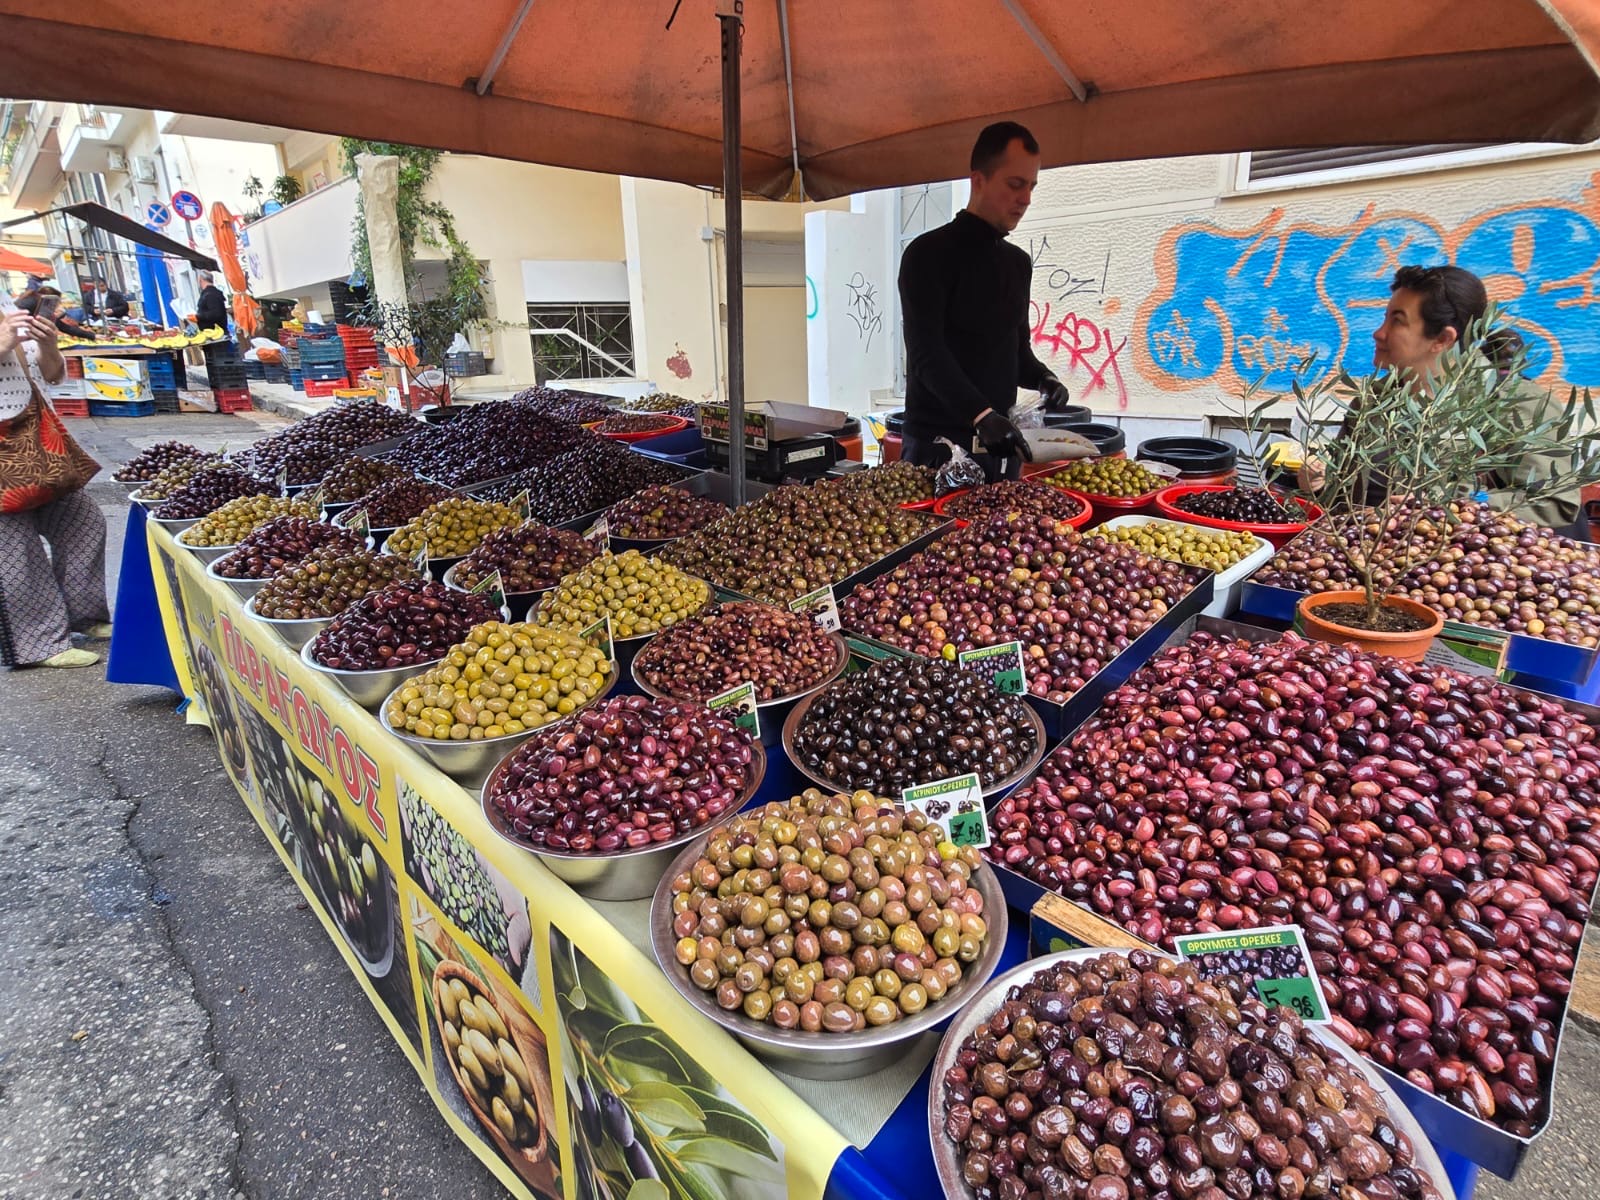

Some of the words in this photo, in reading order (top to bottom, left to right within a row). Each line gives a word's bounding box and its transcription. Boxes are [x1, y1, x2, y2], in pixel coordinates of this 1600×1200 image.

[219, 611, 388, 841] ΠΑΡΑΓΩΓΟΣ
[912, 787, 941, 799] ΑΓΡΙΝΙΟΥ
[942, 778, 971, 791] ΦΡΕΣΚΕΣ
[1187, 937, 1239, 952] ΘΡΟΥΜΠΕΣ
[1240, 933, 1283, 948] ΦΡΕΣΚΕΣ
